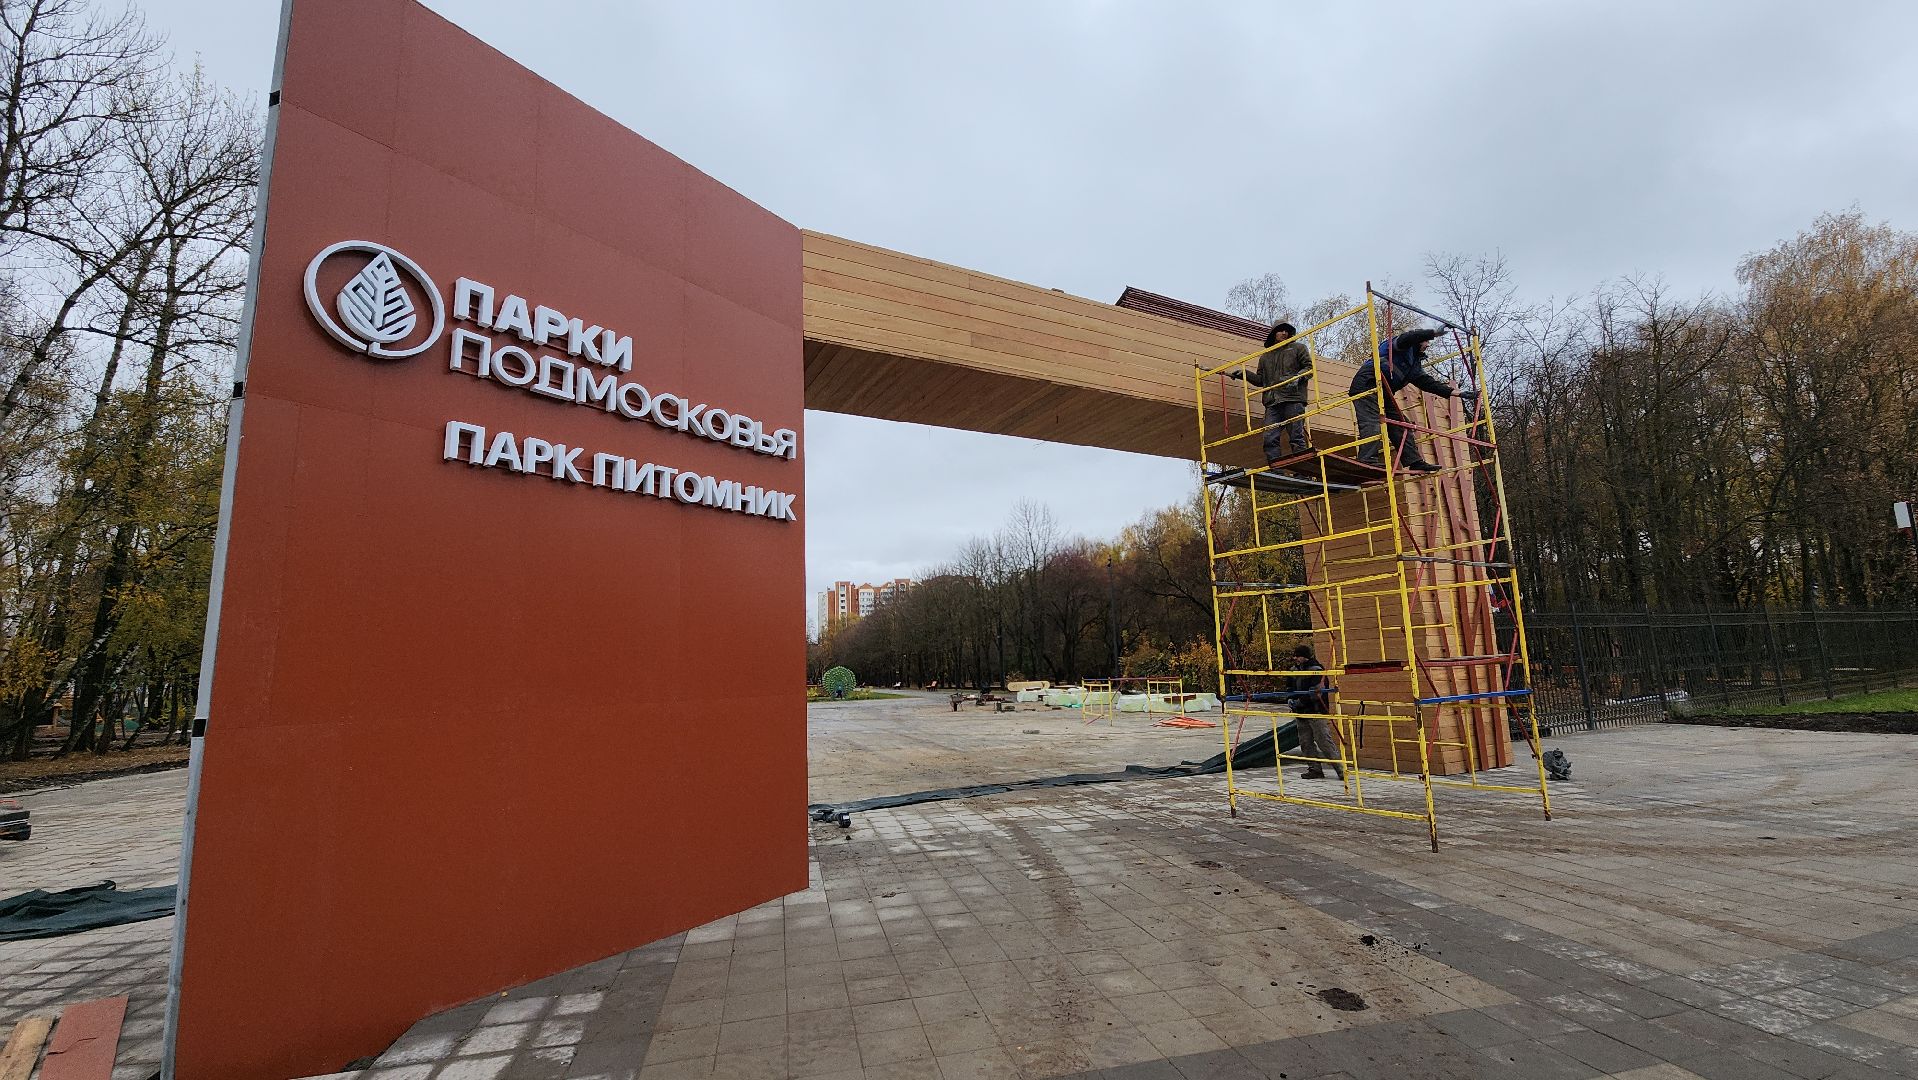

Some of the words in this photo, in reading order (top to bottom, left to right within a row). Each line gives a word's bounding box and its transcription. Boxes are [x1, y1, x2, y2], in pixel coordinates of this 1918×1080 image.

[453, 276, 633, 373] ПАРКИ
[449, 327, 798, 460] ПОДМОСКОВЬЯ
[443, 420, 585, 483] ПАРК
[592, 451, 798, 522] ПИТОМНИК
